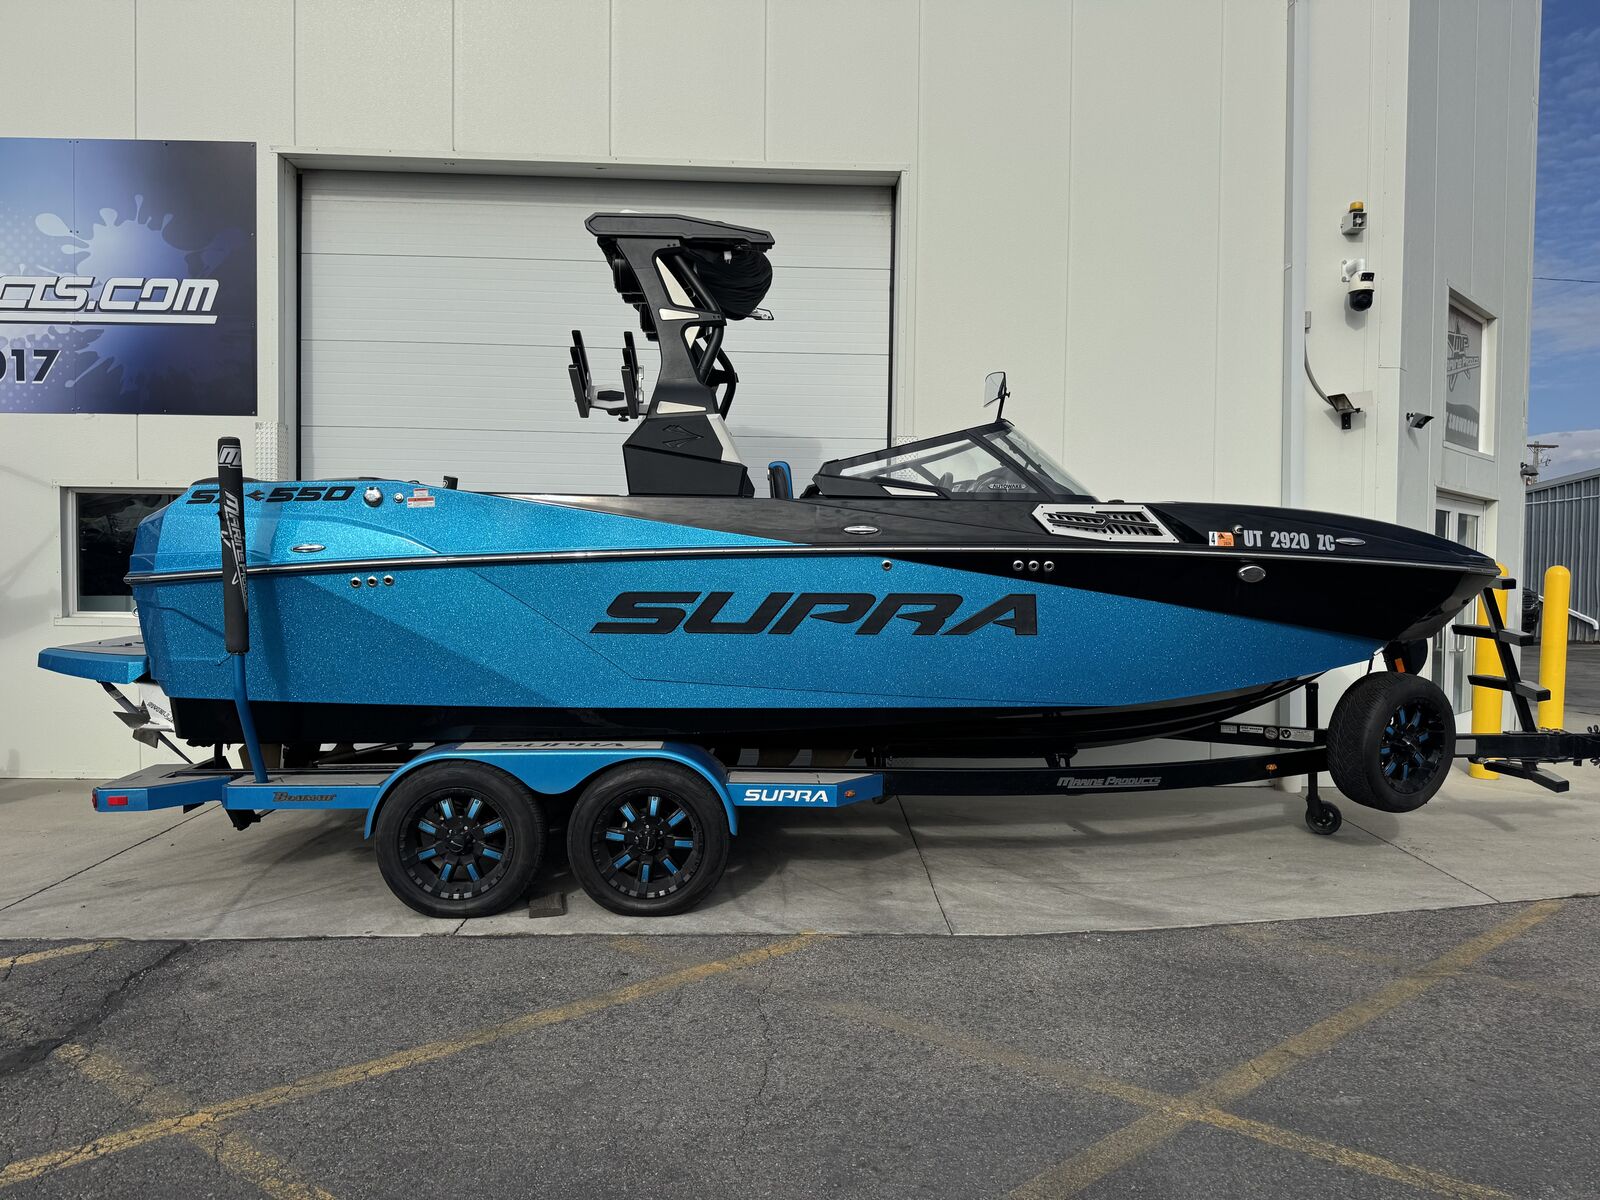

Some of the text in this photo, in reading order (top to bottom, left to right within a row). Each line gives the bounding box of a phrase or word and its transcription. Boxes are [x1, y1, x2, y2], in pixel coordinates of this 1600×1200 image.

[0, 349, 61, 383] 17
[266, 486, 356, 502] 550
[1243, 530, 1336, 551] UT 2920 ZC
[590, 591, 1038, 636] SUPRA
[1057, 776, 1162, 787] MARINE PRODUCTS
[744, 789, 829, 803] SUPRA
